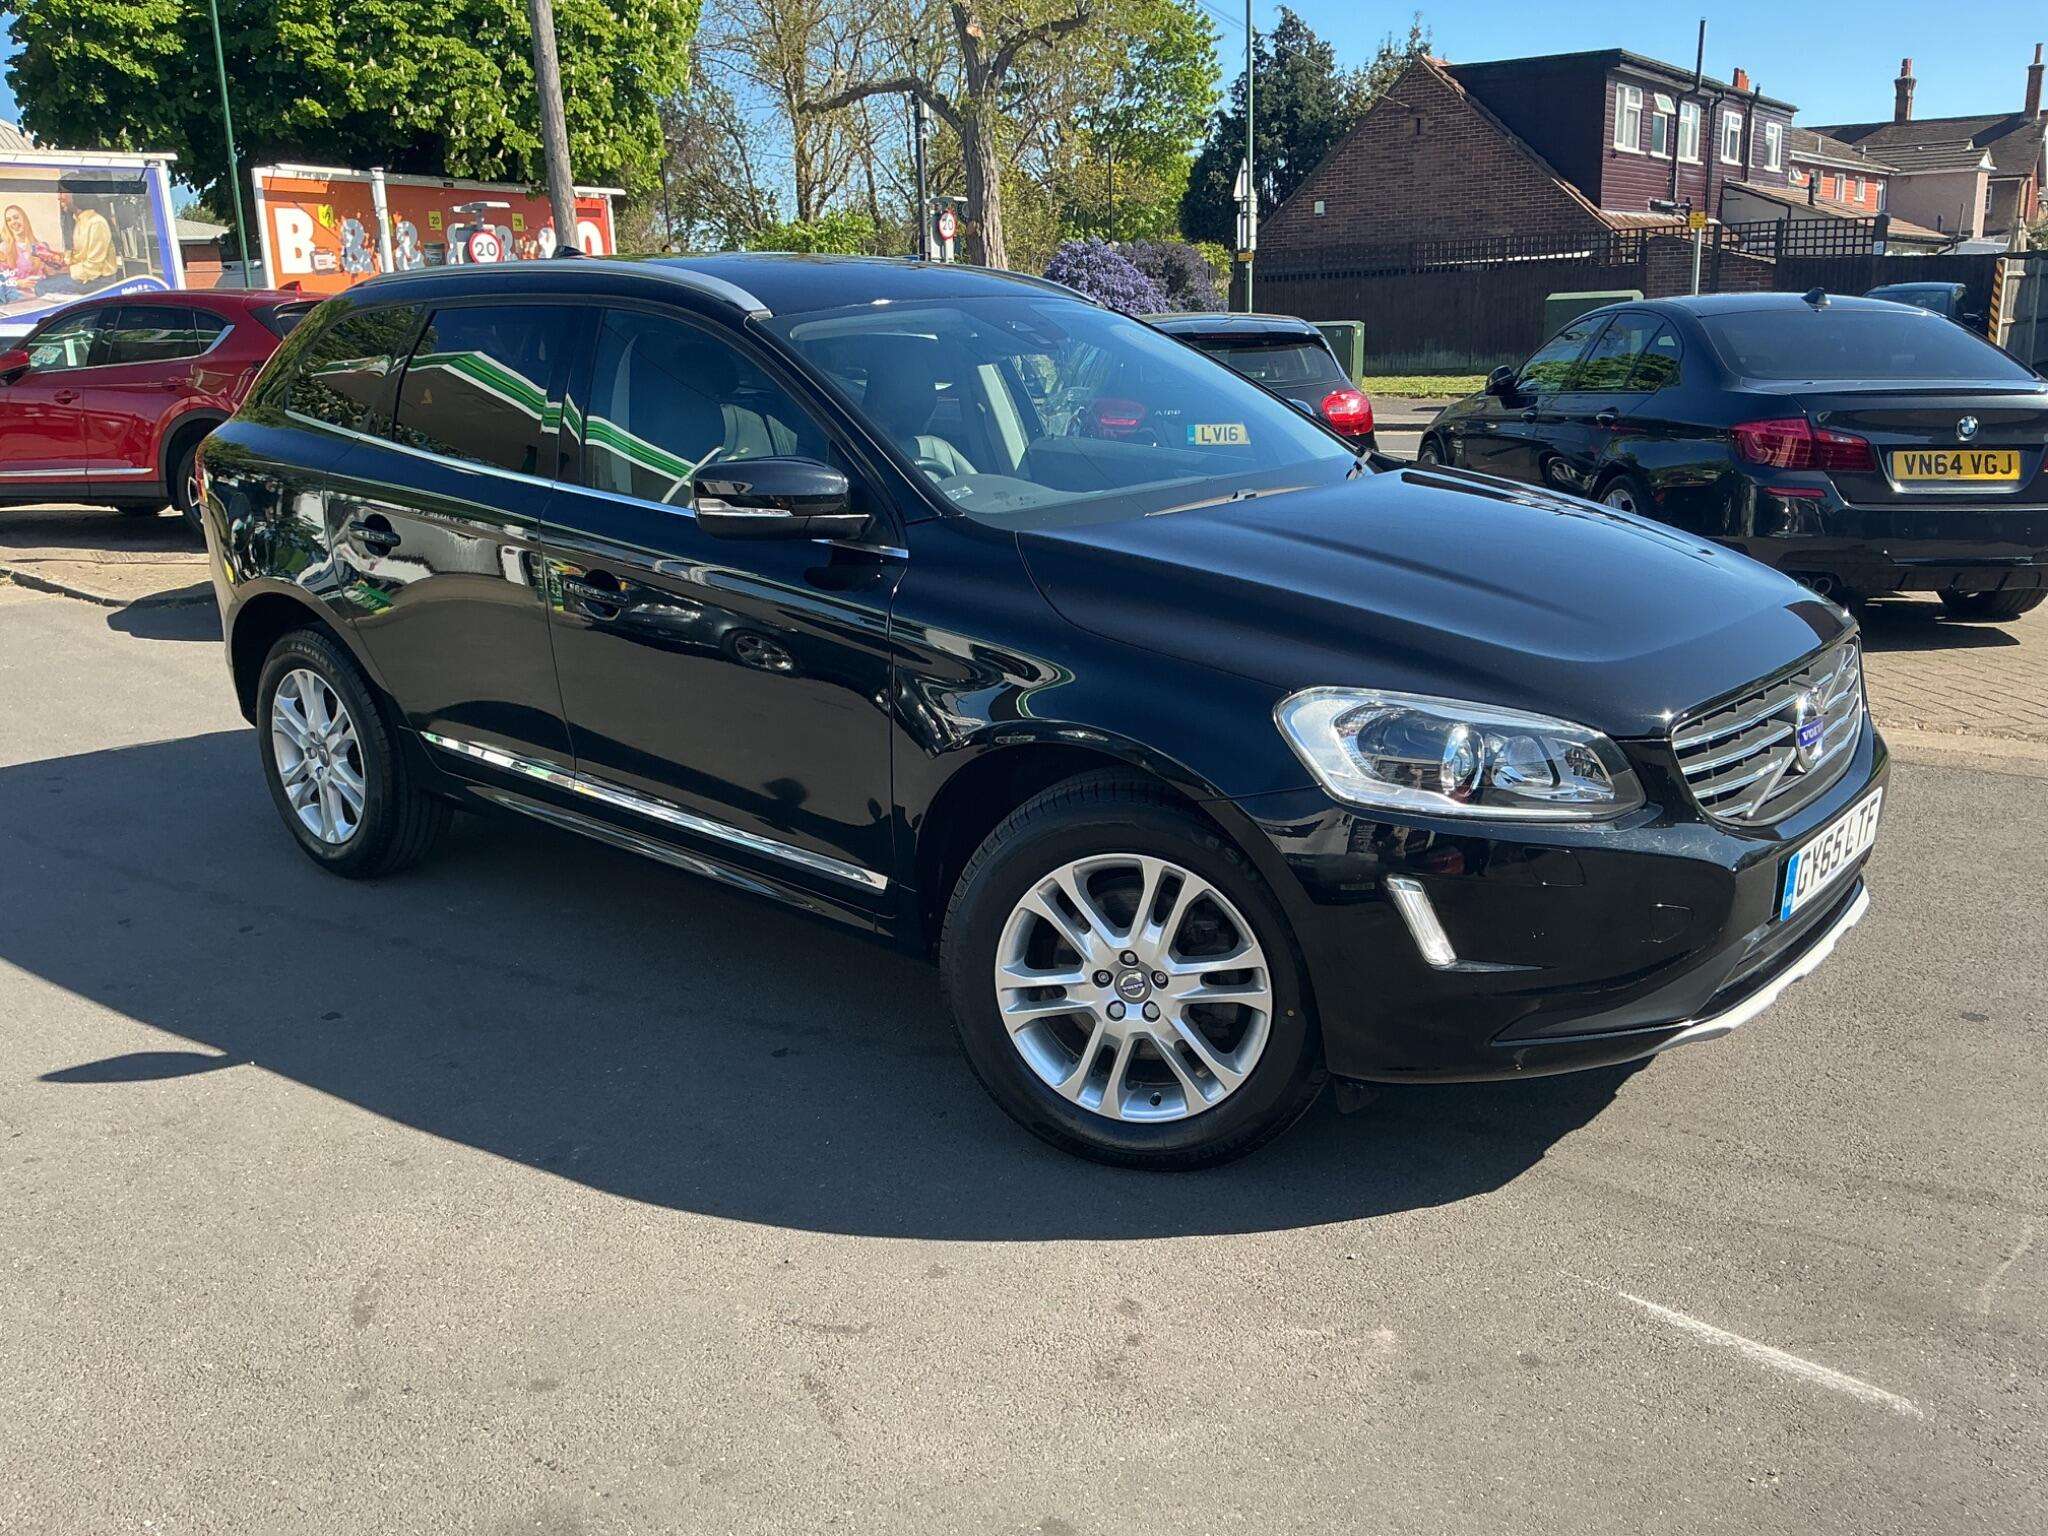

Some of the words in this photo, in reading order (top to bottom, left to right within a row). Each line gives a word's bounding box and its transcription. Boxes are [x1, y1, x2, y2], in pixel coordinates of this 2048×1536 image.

[474, 241, 497, 256] 20
[1904, 453, 1963, 475] VN64
[1970, 453, 2013, 475] VGJ
[1796, 822, 1846, 898] GY65
[1844, 796, 1879, 857] LTF
